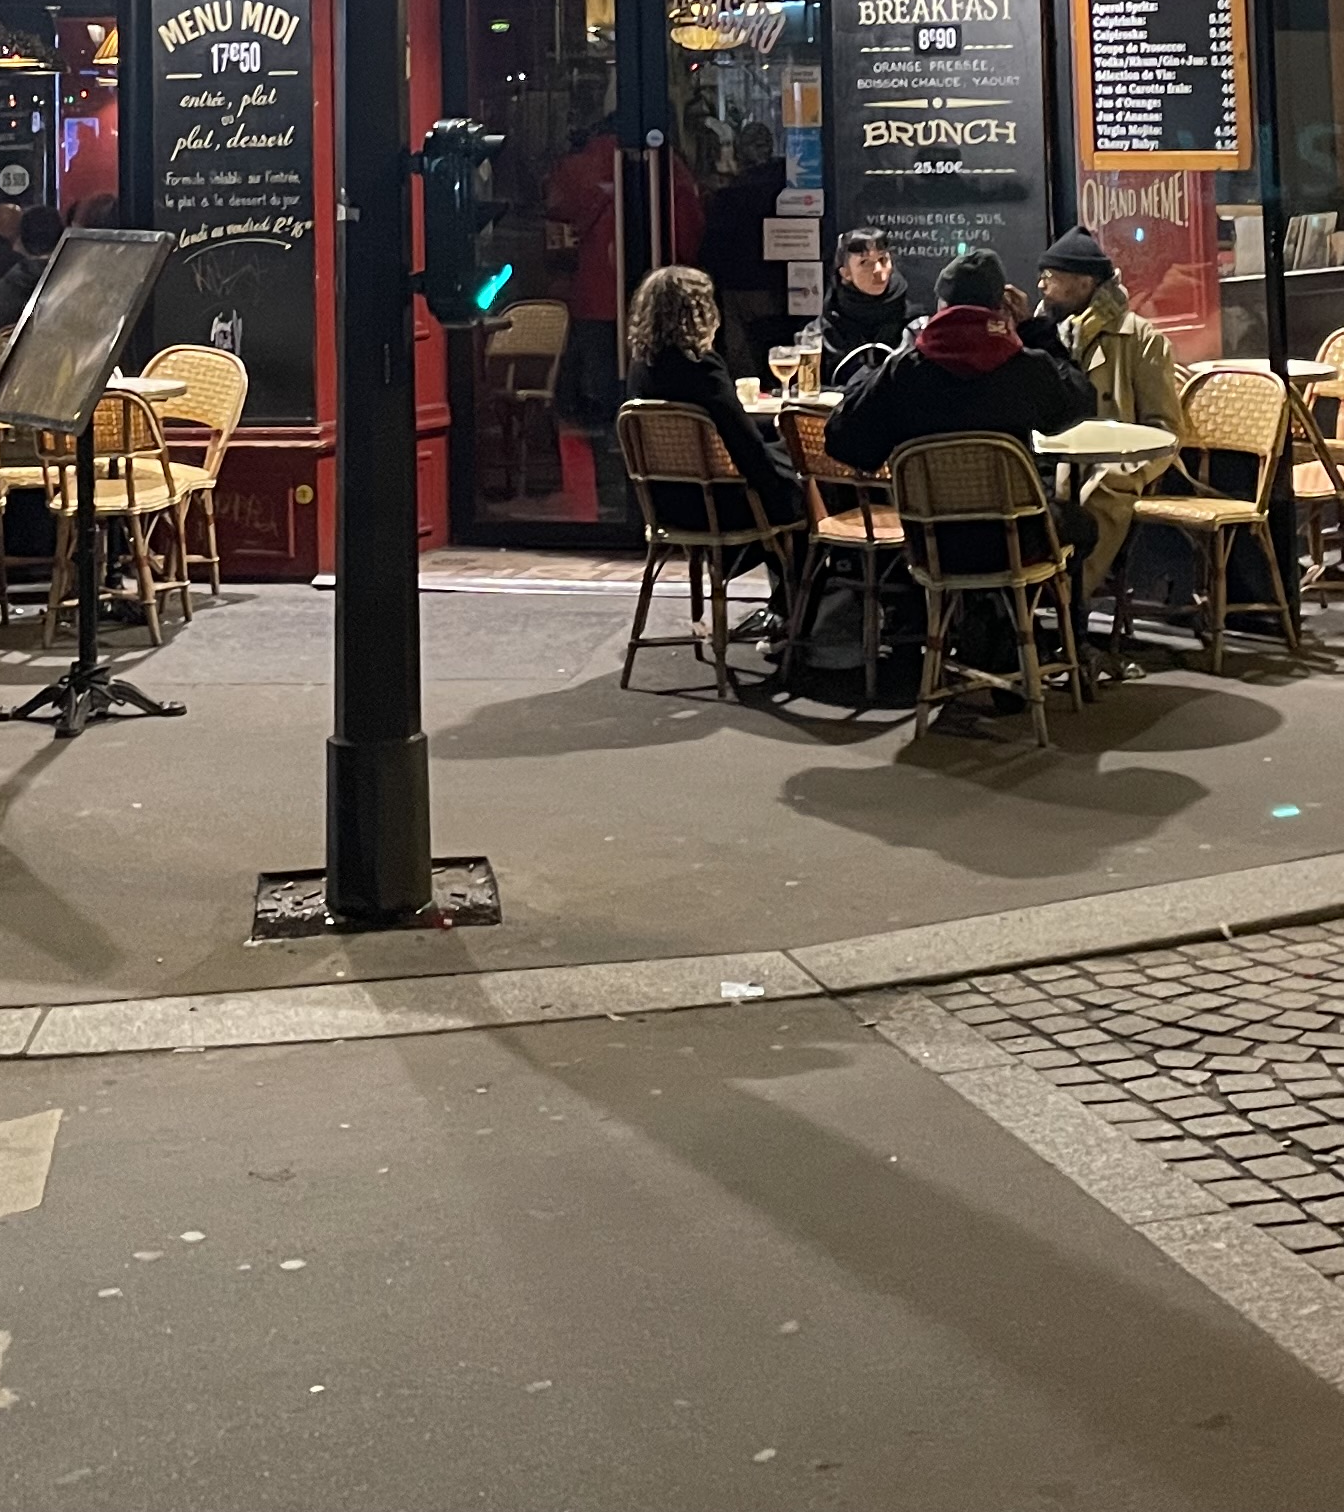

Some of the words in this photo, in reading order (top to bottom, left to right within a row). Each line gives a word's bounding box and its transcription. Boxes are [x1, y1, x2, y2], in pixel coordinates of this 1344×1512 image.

[157, 0, 233, 53] MENU
[241, 0, 300, 45] MIDI
[873, 61, 923, 73] ORANGE
[236, 84, 277, 118] plat
[227, 123, 295, 149] dessert
[863, 119, 1017, 148] BRUNCH
[1082, 178, 1137, 232] QUAND
